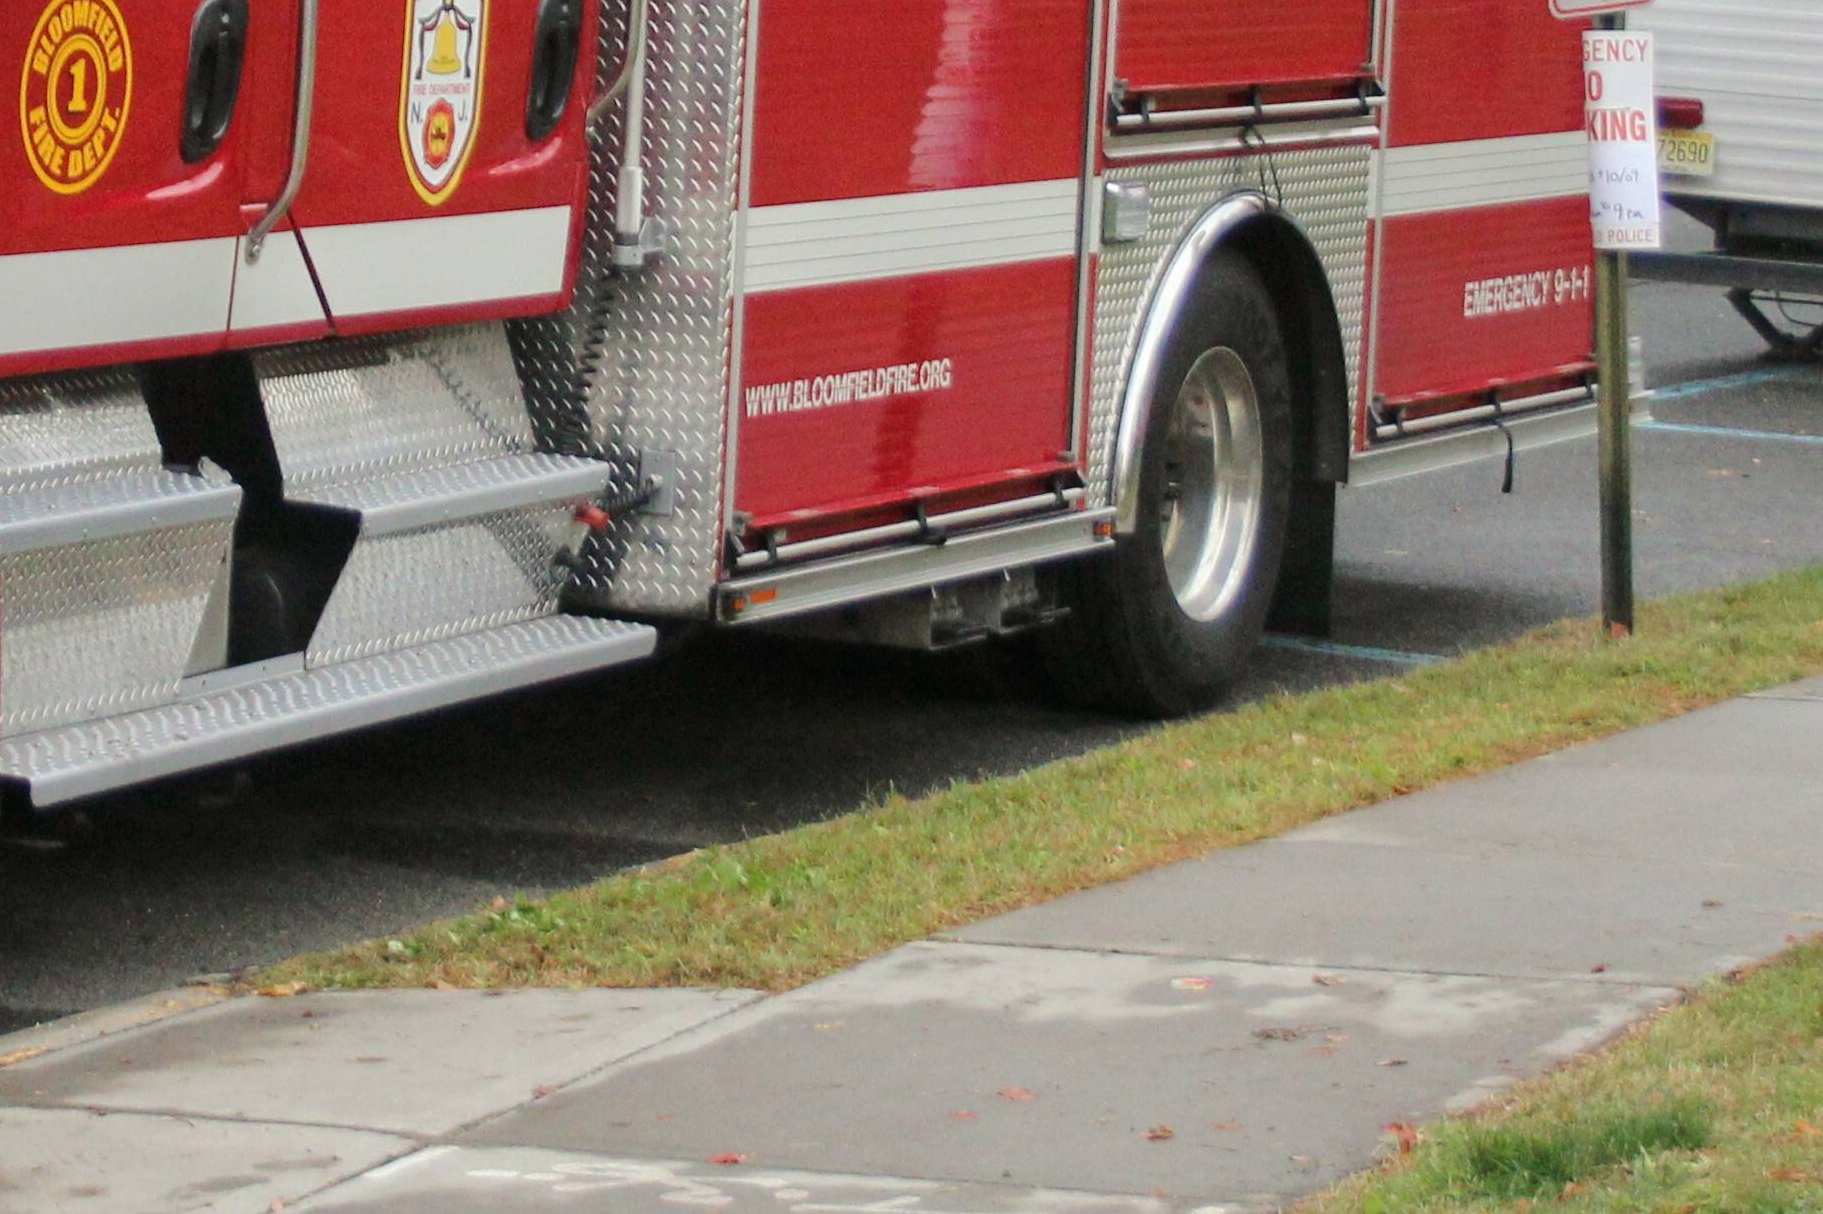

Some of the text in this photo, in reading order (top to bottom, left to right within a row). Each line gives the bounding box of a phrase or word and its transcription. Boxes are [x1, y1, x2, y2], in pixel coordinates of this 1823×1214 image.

[32, 0, 124, 75] BLOOMFIELD
[67, 58, 87, 112] 1
[29, 105, 66, 176] FIRE
[1608, 229, 1653, 243] POLICE
[1464, 264, 1590, 317] EMERGENCY 9-1-1
[745, 357, 952, 418] WWW.BLOOMFIELDFIRE.ORG
